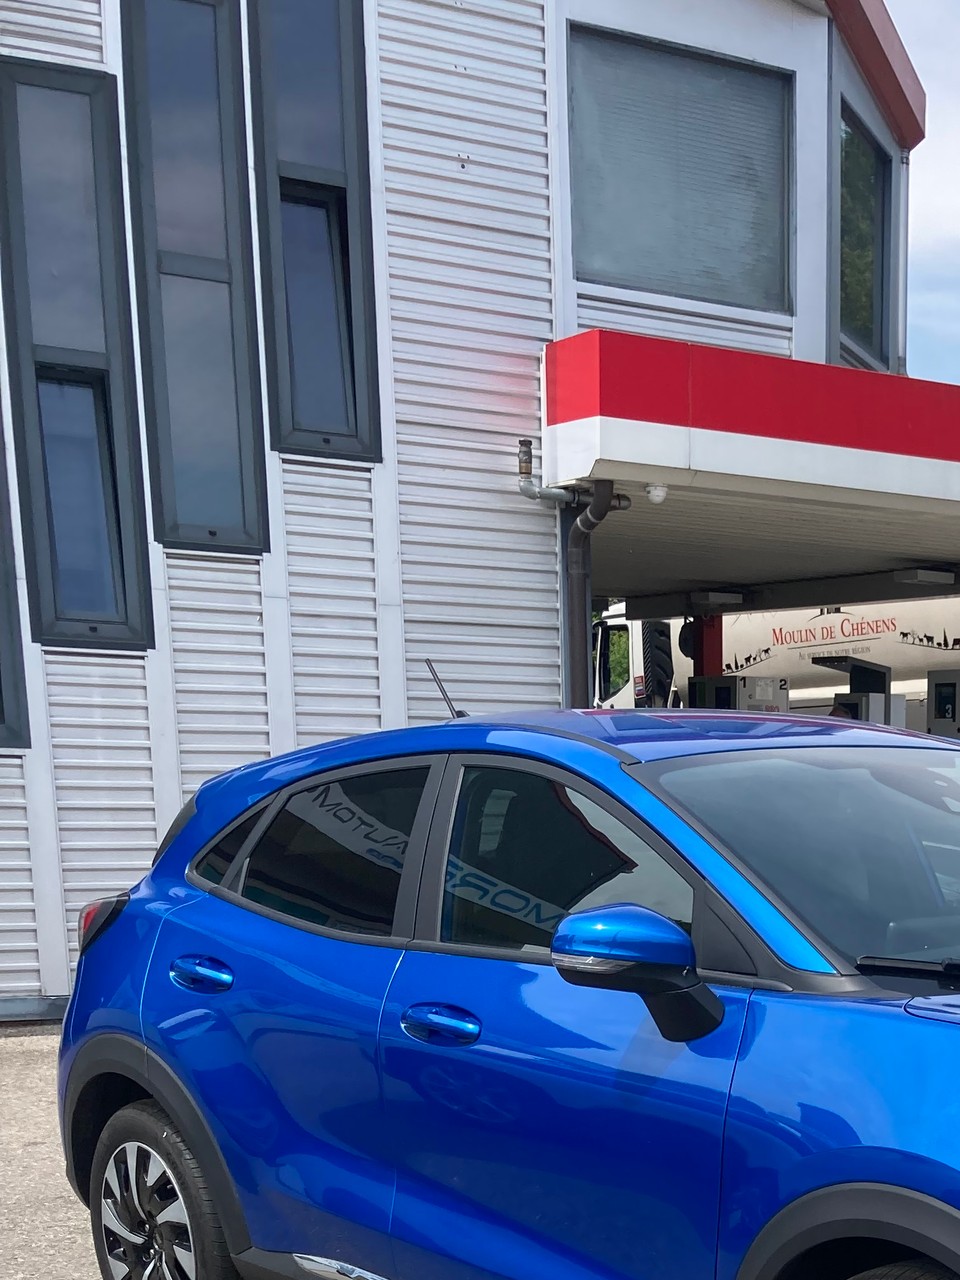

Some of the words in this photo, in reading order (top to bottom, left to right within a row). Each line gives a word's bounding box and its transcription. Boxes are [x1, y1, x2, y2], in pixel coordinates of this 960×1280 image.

[772, 627, 817, 646] MOULIN
[821, 625, 836, 641] DE
[840, 616, 897, 638] CHÉNENS
[740, 676, 747, 689] 1
[779, 678, 788, 690] 2
[945, 704, 952, 718] 3
